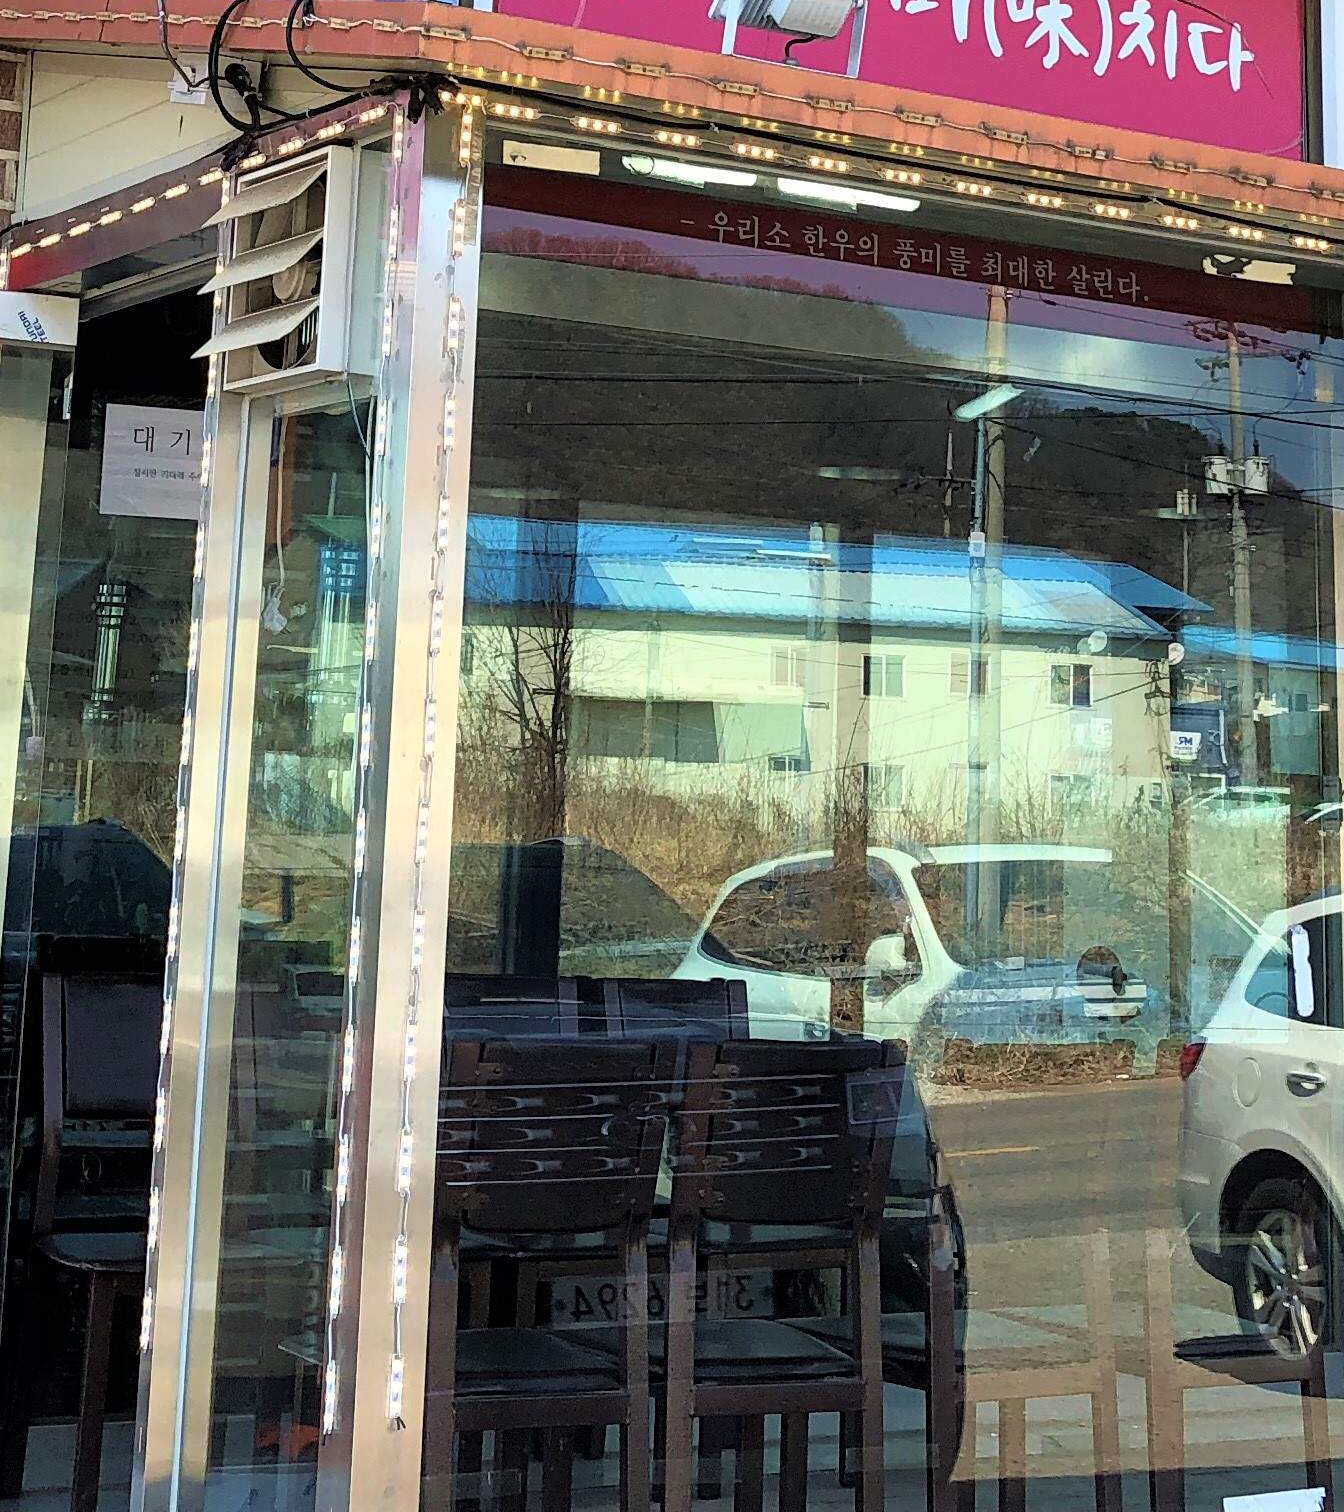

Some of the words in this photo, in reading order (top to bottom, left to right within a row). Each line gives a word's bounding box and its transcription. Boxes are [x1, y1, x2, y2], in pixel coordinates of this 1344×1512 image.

[707, 210, 792, 250] 우리소
[802, 223, 880, 267] 한우의
[891, 237, 972, 279] 풍미를
[980, 251, 1057, 289] 최대한
[1065, 264, 1150, 303] 살린다.
